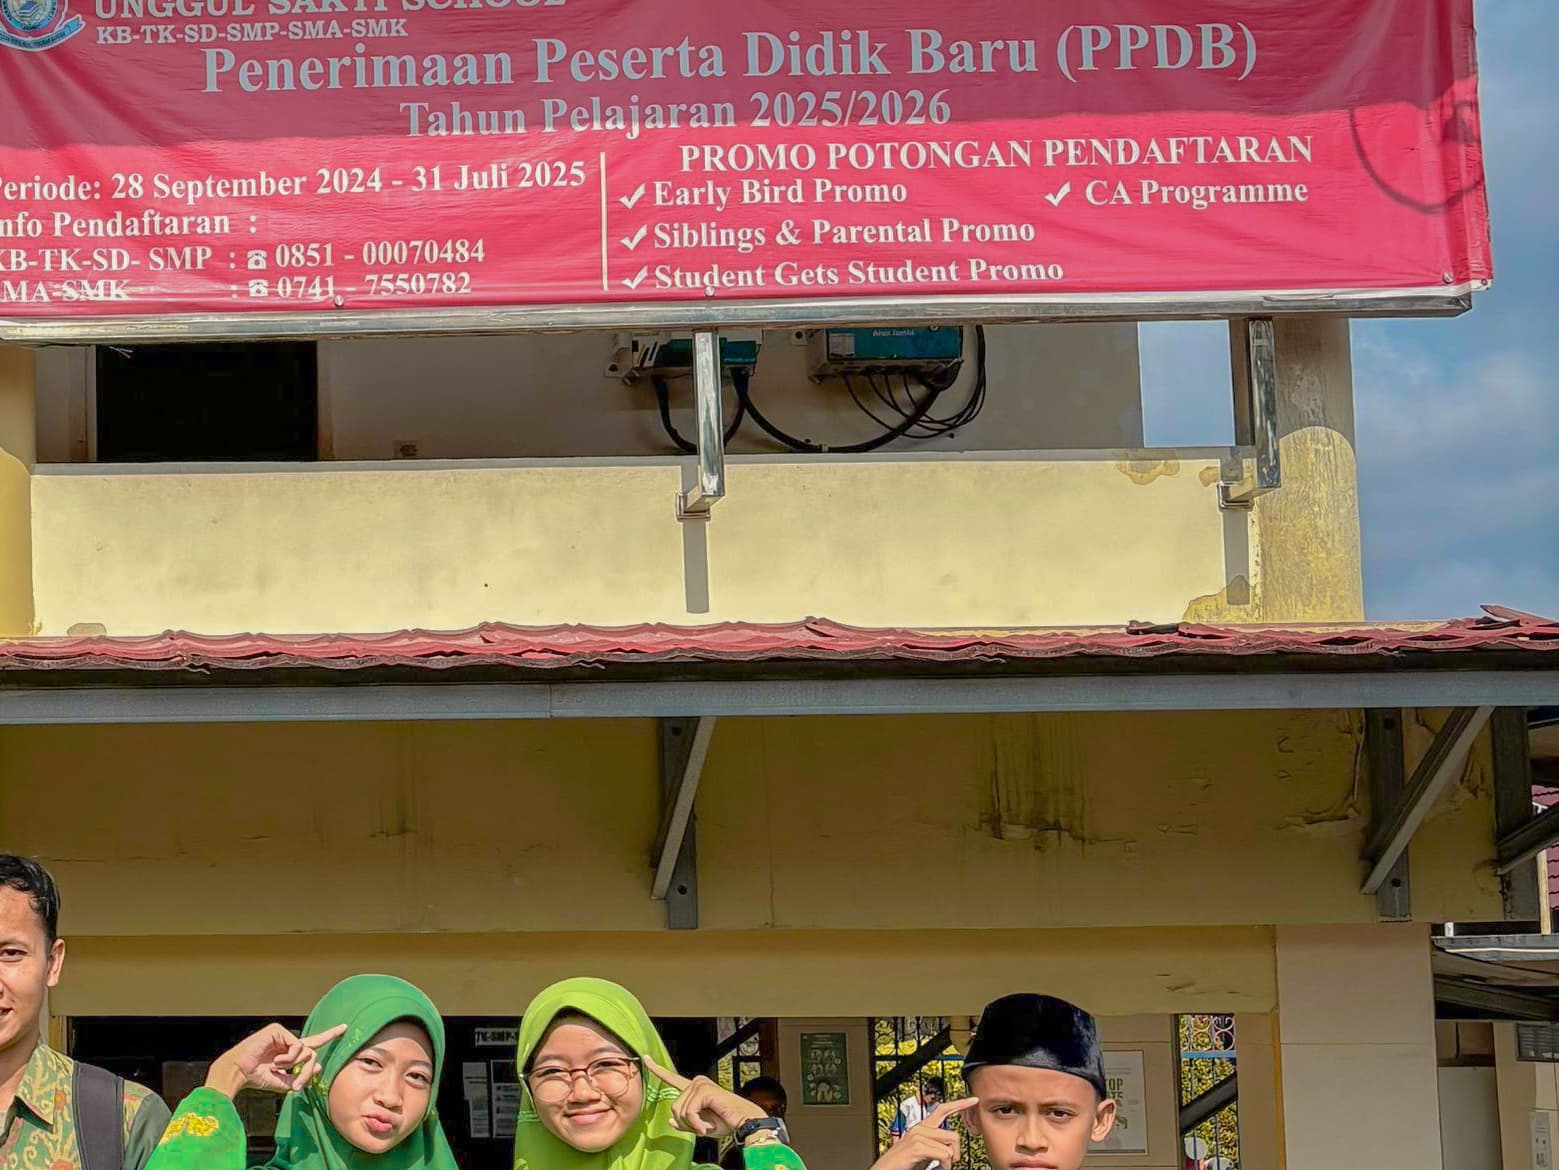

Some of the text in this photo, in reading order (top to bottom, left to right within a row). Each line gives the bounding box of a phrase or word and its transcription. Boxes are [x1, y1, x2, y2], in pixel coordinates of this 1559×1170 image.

[97, 19, 407, 45] KB-TK-SD-SMP-SMA-SMK
[201, 22, 1258, 93] Penerimaan Peserta Didik Baru (PPDB)
[399, 89, 951, 140] Tahun Pelajaran 2025/2026
[680, 136, 1312, 172] PROMO POTONGAN PENDAFTARAN
[111, 173, 143, 200] 28
[153, 171, 307, 205] September
[315, 167, 383, 194] 2024
[412, 166, 441, 192] 31
[453, 164, 509, 192] Juli
[518, 161, 585, 188] 2025
[654, 178, 907, 212] Early Bird Promo
[1085, 180, 1309, 210] CA Programme
[53, 209, 230, 238] Pendaftaran
[654, 217, 1035, 254] Siblings & Parental Promo
[148, 246, 213, 272] SMP
[275, 242, 336, 267] 0851
[362, 239, 485, 266] 00070484
[277, 275, 336, 299] 0741
[365, 271, 472, 296] 7550782
[654, 258, 1063, 290] Student Gets Student Promo
